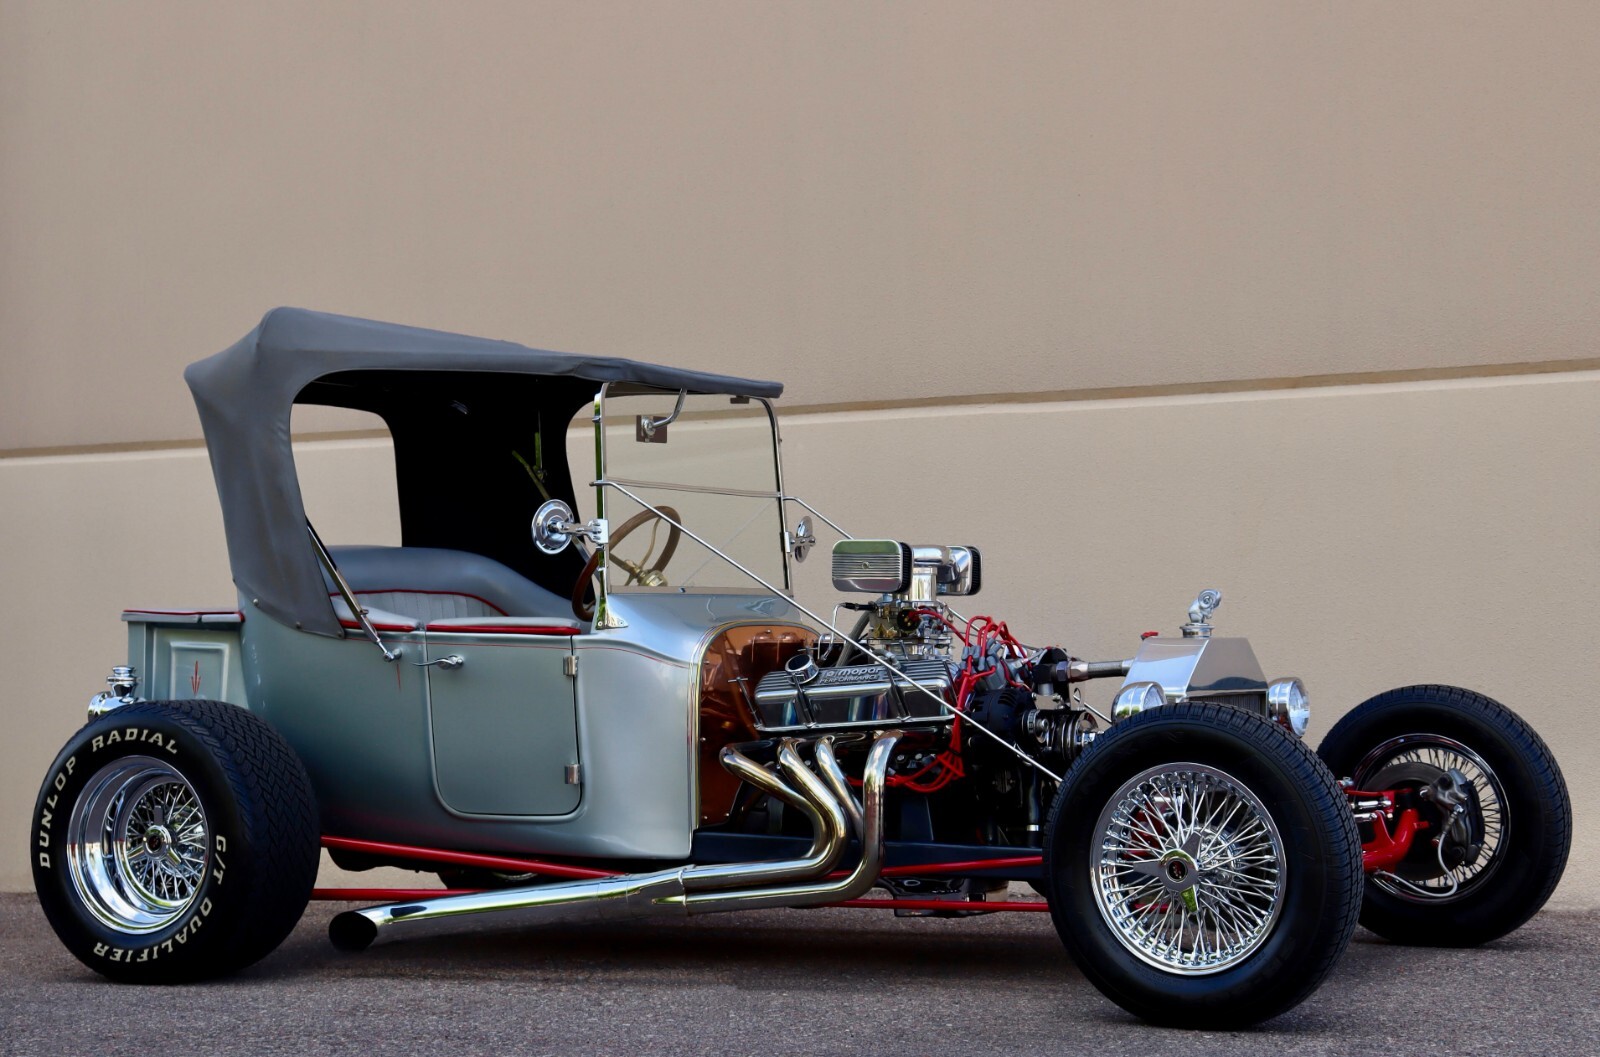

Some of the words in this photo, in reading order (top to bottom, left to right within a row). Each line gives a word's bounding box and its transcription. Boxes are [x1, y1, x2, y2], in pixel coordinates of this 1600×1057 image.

[39, 756, 77, 868] DUNLOP
[91, 728, 178, 754] RADIAL
[213, 835, 226, 885] G/T
[93, 897, 212, 962] QUALIFIER
